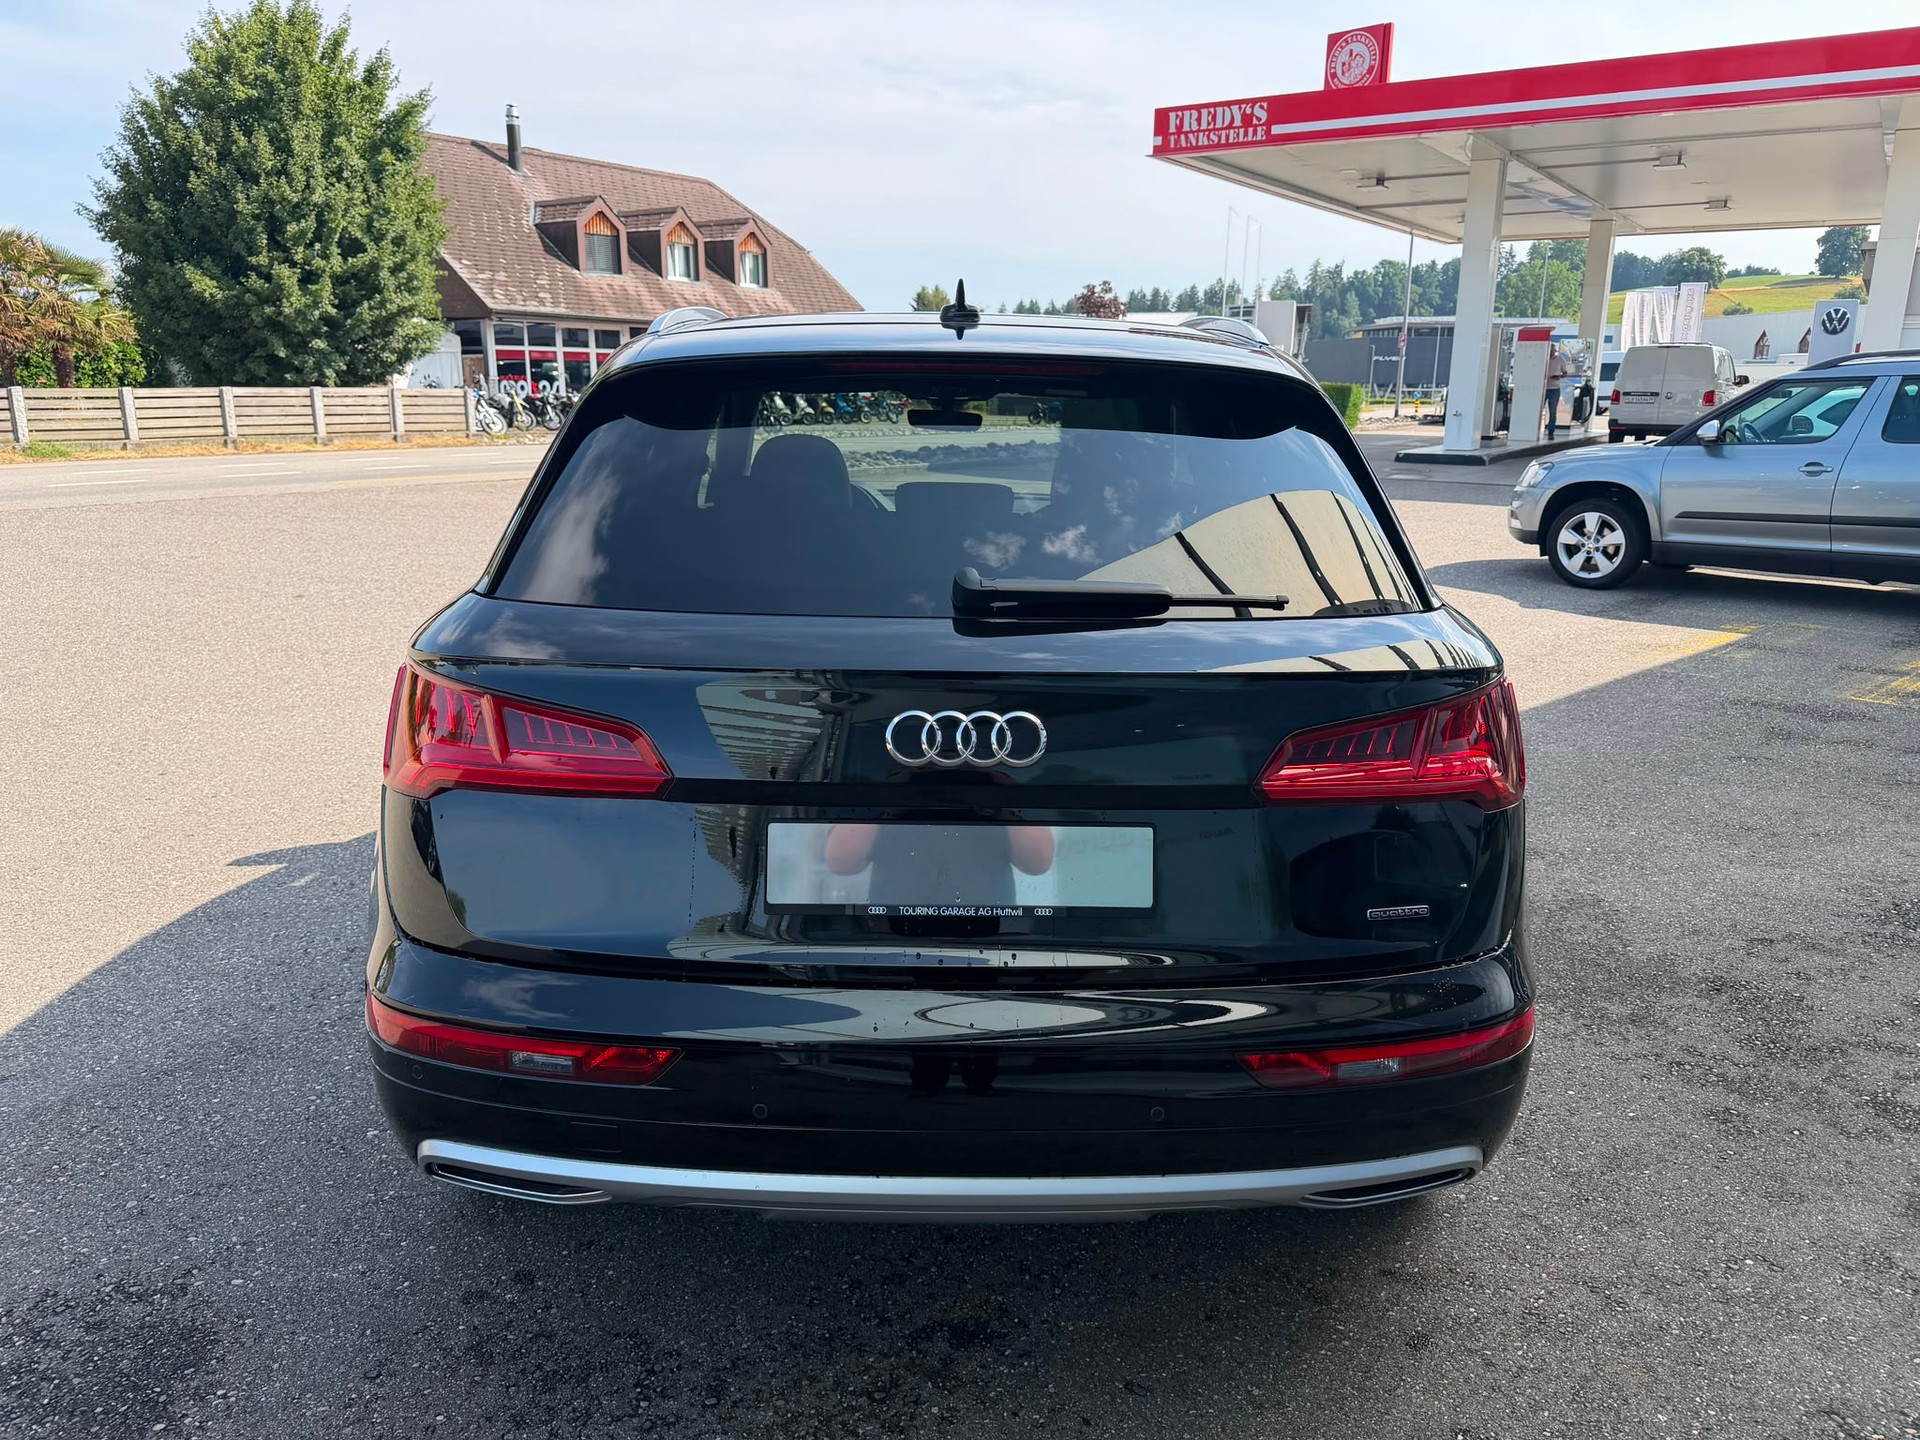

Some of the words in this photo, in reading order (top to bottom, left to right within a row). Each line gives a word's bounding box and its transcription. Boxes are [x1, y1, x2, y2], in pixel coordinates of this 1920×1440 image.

[1168, 102, 1268, 133] FREDY'S
[1168, 126, 1267, 149] TANKSTELLE
[899, 906, 939, 916] TOURING
[940, 906, 976, 916] GARAGE
[978, 907, 991, 916] AG
[993, 907, 1022, 917] Huttwil
[1371, 907, 1428, 919] quattro
